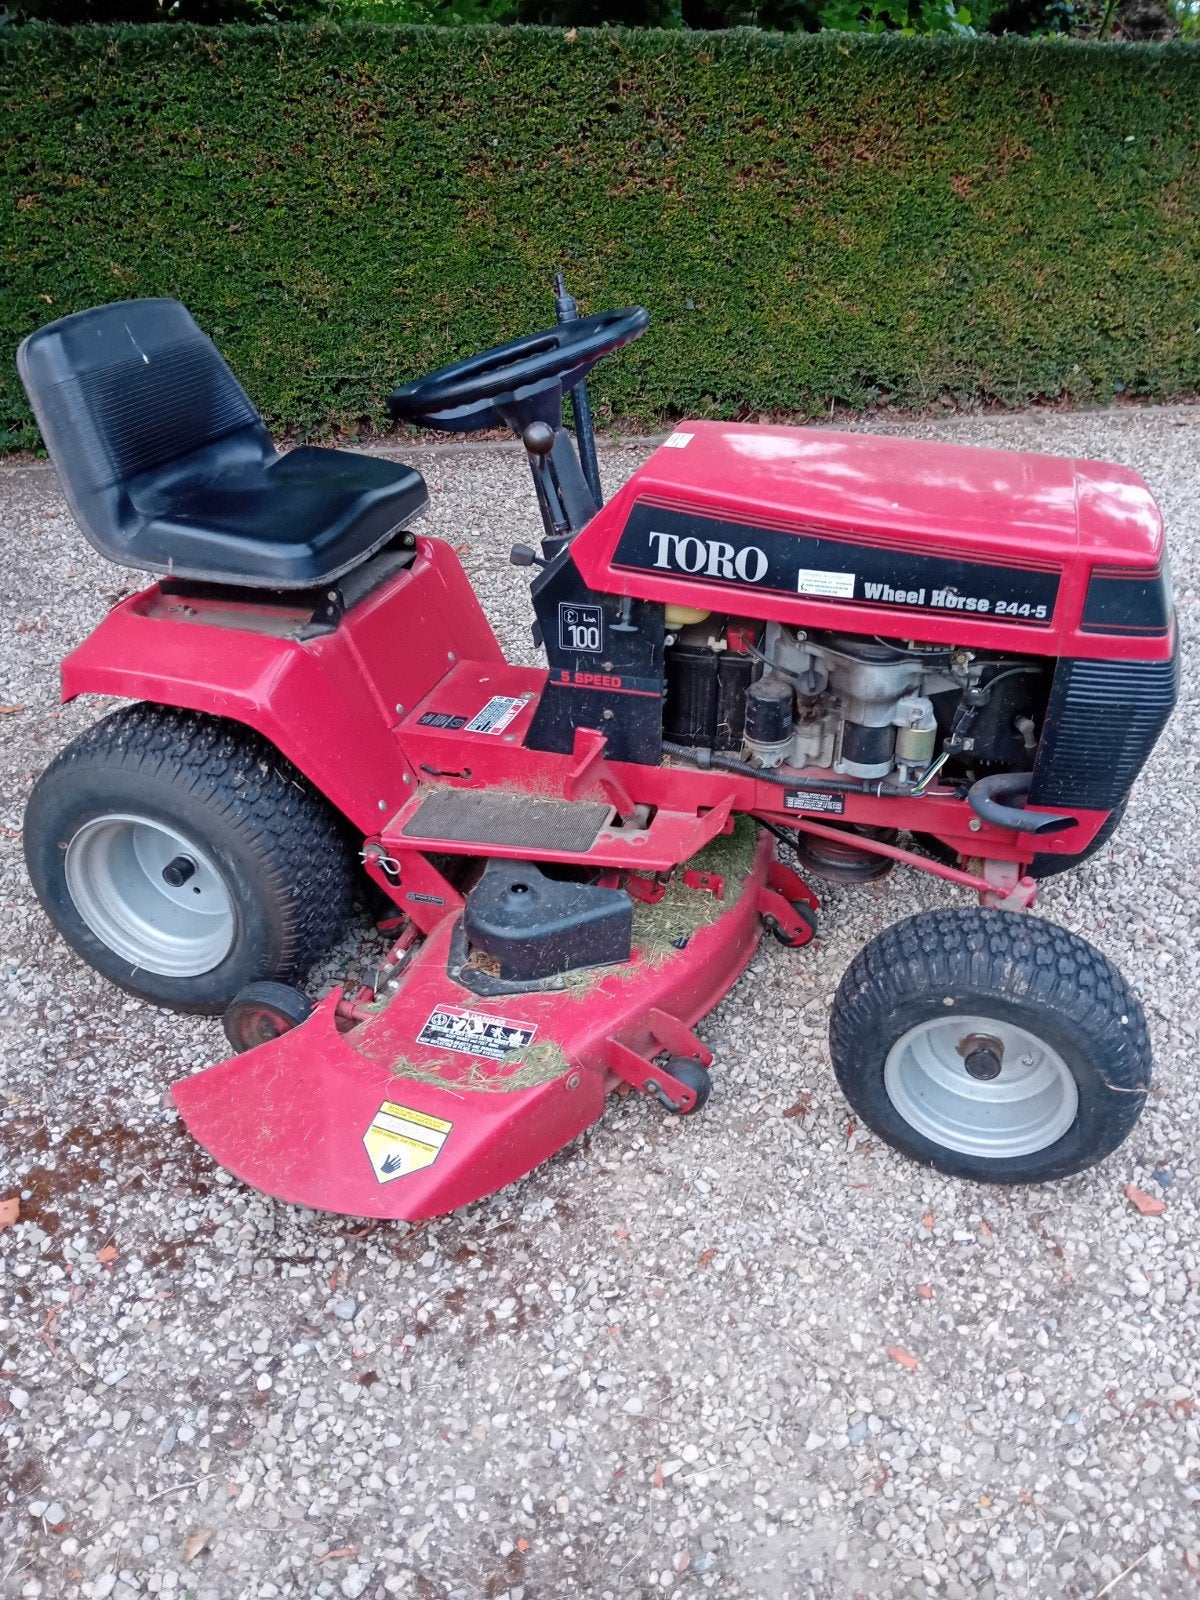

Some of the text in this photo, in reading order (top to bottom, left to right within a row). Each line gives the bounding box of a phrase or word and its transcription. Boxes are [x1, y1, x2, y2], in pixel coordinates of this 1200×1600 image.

[648, 531, 769, 582] TORO
[864, 582, 926, 605] Wheel
[930, 590, 990, 612] Horse
[994, 600, 1048, 618] 244-5
[568, 625, 599, 649] 100
[561, 671, 622, 688] 5 SPEED
